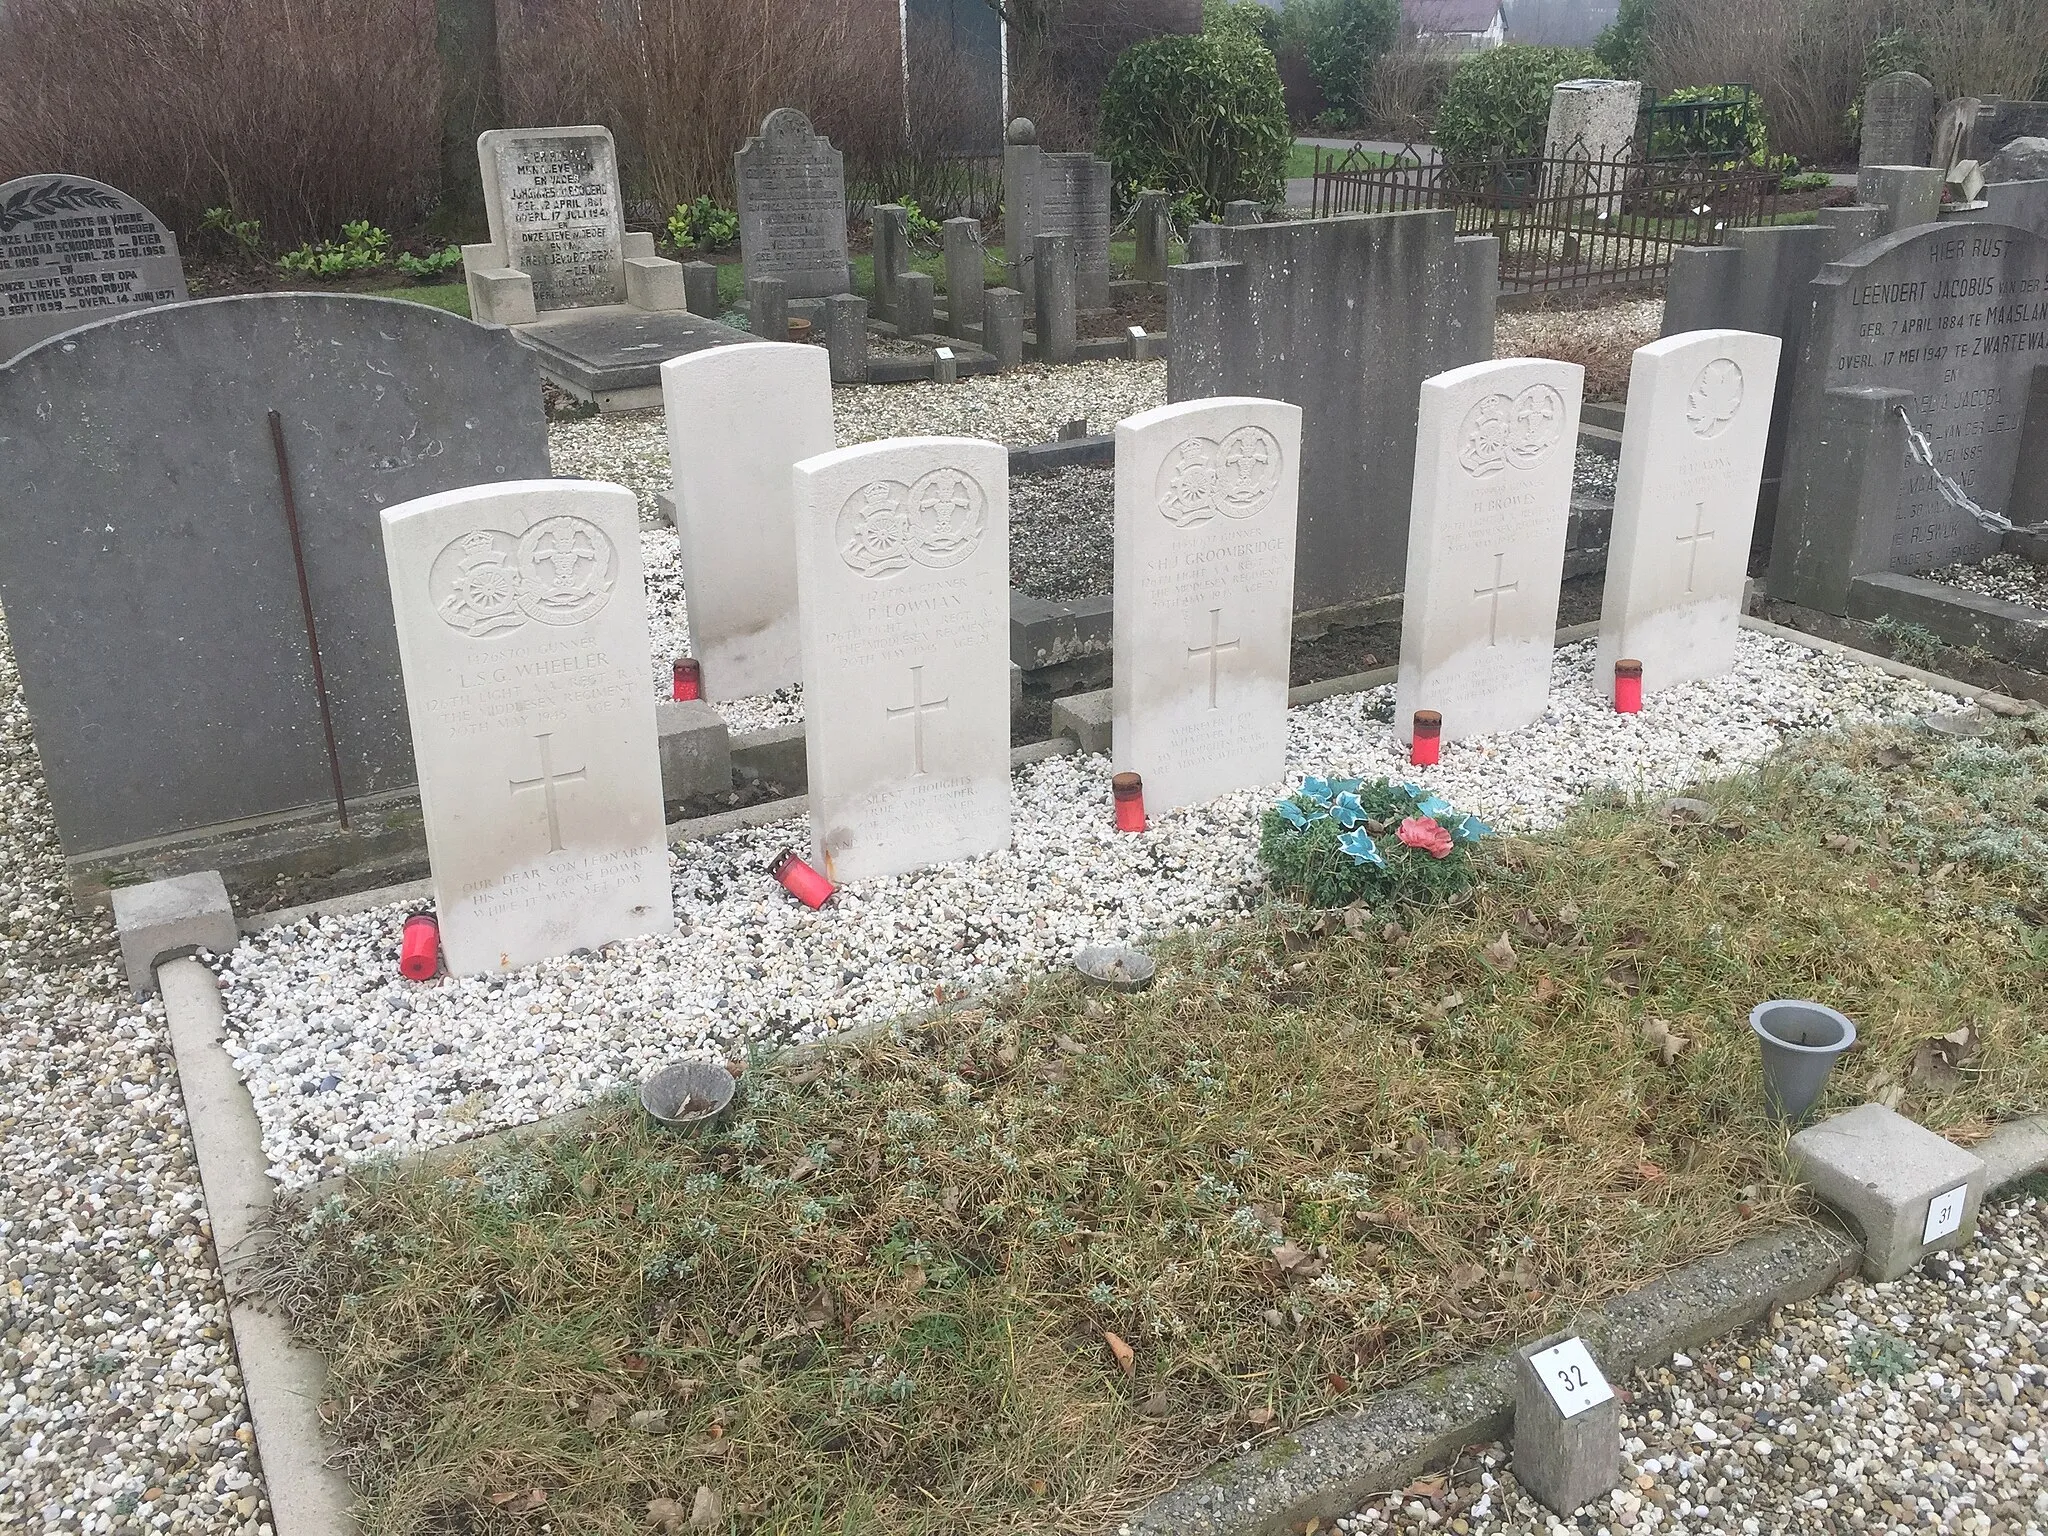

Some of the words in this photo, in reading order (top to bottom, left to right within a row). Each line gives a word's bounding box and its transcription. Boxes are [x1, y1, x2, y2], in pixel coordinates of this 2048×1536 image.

[554, 199, 582, 209] APRIL
[60, 217, 94, 228] RUSTE
[0, 234, 20, 245] NZE
[24, 232, 55, 243] LIEVE
[58, 228, 94, 240] VROUW
[98, 226, 112, 236] EN
[114, 223, 155, 236] MOEDER
[102, 250, 116, 260] 26
[142, 245, 166, 256] 1958
[1930, 240, 1966, 263] HIER
[1972, 239, 2014, 258] RUST
[28, 278, 61, 289] LIEVE
[64, 274, 98, 286] VADER
[101, 272, 115, 282] EN
[118, 270, 138, 280] OPA
[8, 288, 67, 304] MATTHEUS
[78, 296, 116, 308] OVERL.
[156, 290, 176, 300] 1971
[1852, 281, 1928, 306] LEENDERT
[1933, 276, 1996, 300] JACOBUS
[2000, 281, 2016, 294] VAN
[2020, 279, 2040, 293] DER
[1860, 322, 1885, 338] GEB.
[1900, 318, 1932, 334] APRIL
[1938, 314, 1964, 330] 1884
[1968, 314, 1982, 328] TE
[1986, 302, 2048, 326] MAASLAN
[1838, 355, 1876, 370] OVERL.
[1884, 351, 1895, 366] 17
[1899, 348, 1920, 364] MEI
[1923, 346, 1948, 361] 1947
[1955, 344, 1968, 358] TE
[1972, 331, 2048, 356] ZWARTEWA
[1944, 368, 1958, 384] EN
[1954, 388, 2002, 410] JACOBA
[1186, 538, 1284, 565] GROOMBRIDGE
[886, 596, 960, 618] LOWMAN
[515, 652, 610, 678] WHEELER
[866, 788, 905, 806] SILENT
[912, 776, 972, 795] THOUGHTS
[462, 879, 494, 893] OUR
[502, 869, 541, 886] DEAR
[548, 861, 577, 874] SON
[473, 894, 495, 906] HIS
[502, 884, 529, 898] SUN
[556, 872, 594, 887] GONE
[600, 861, 642, 876] DOWN
[525, 896, 539, 908] IT
[1939, 1206, 1952, 1224] 31
[1558, 1365, 1588, 1392] 32
